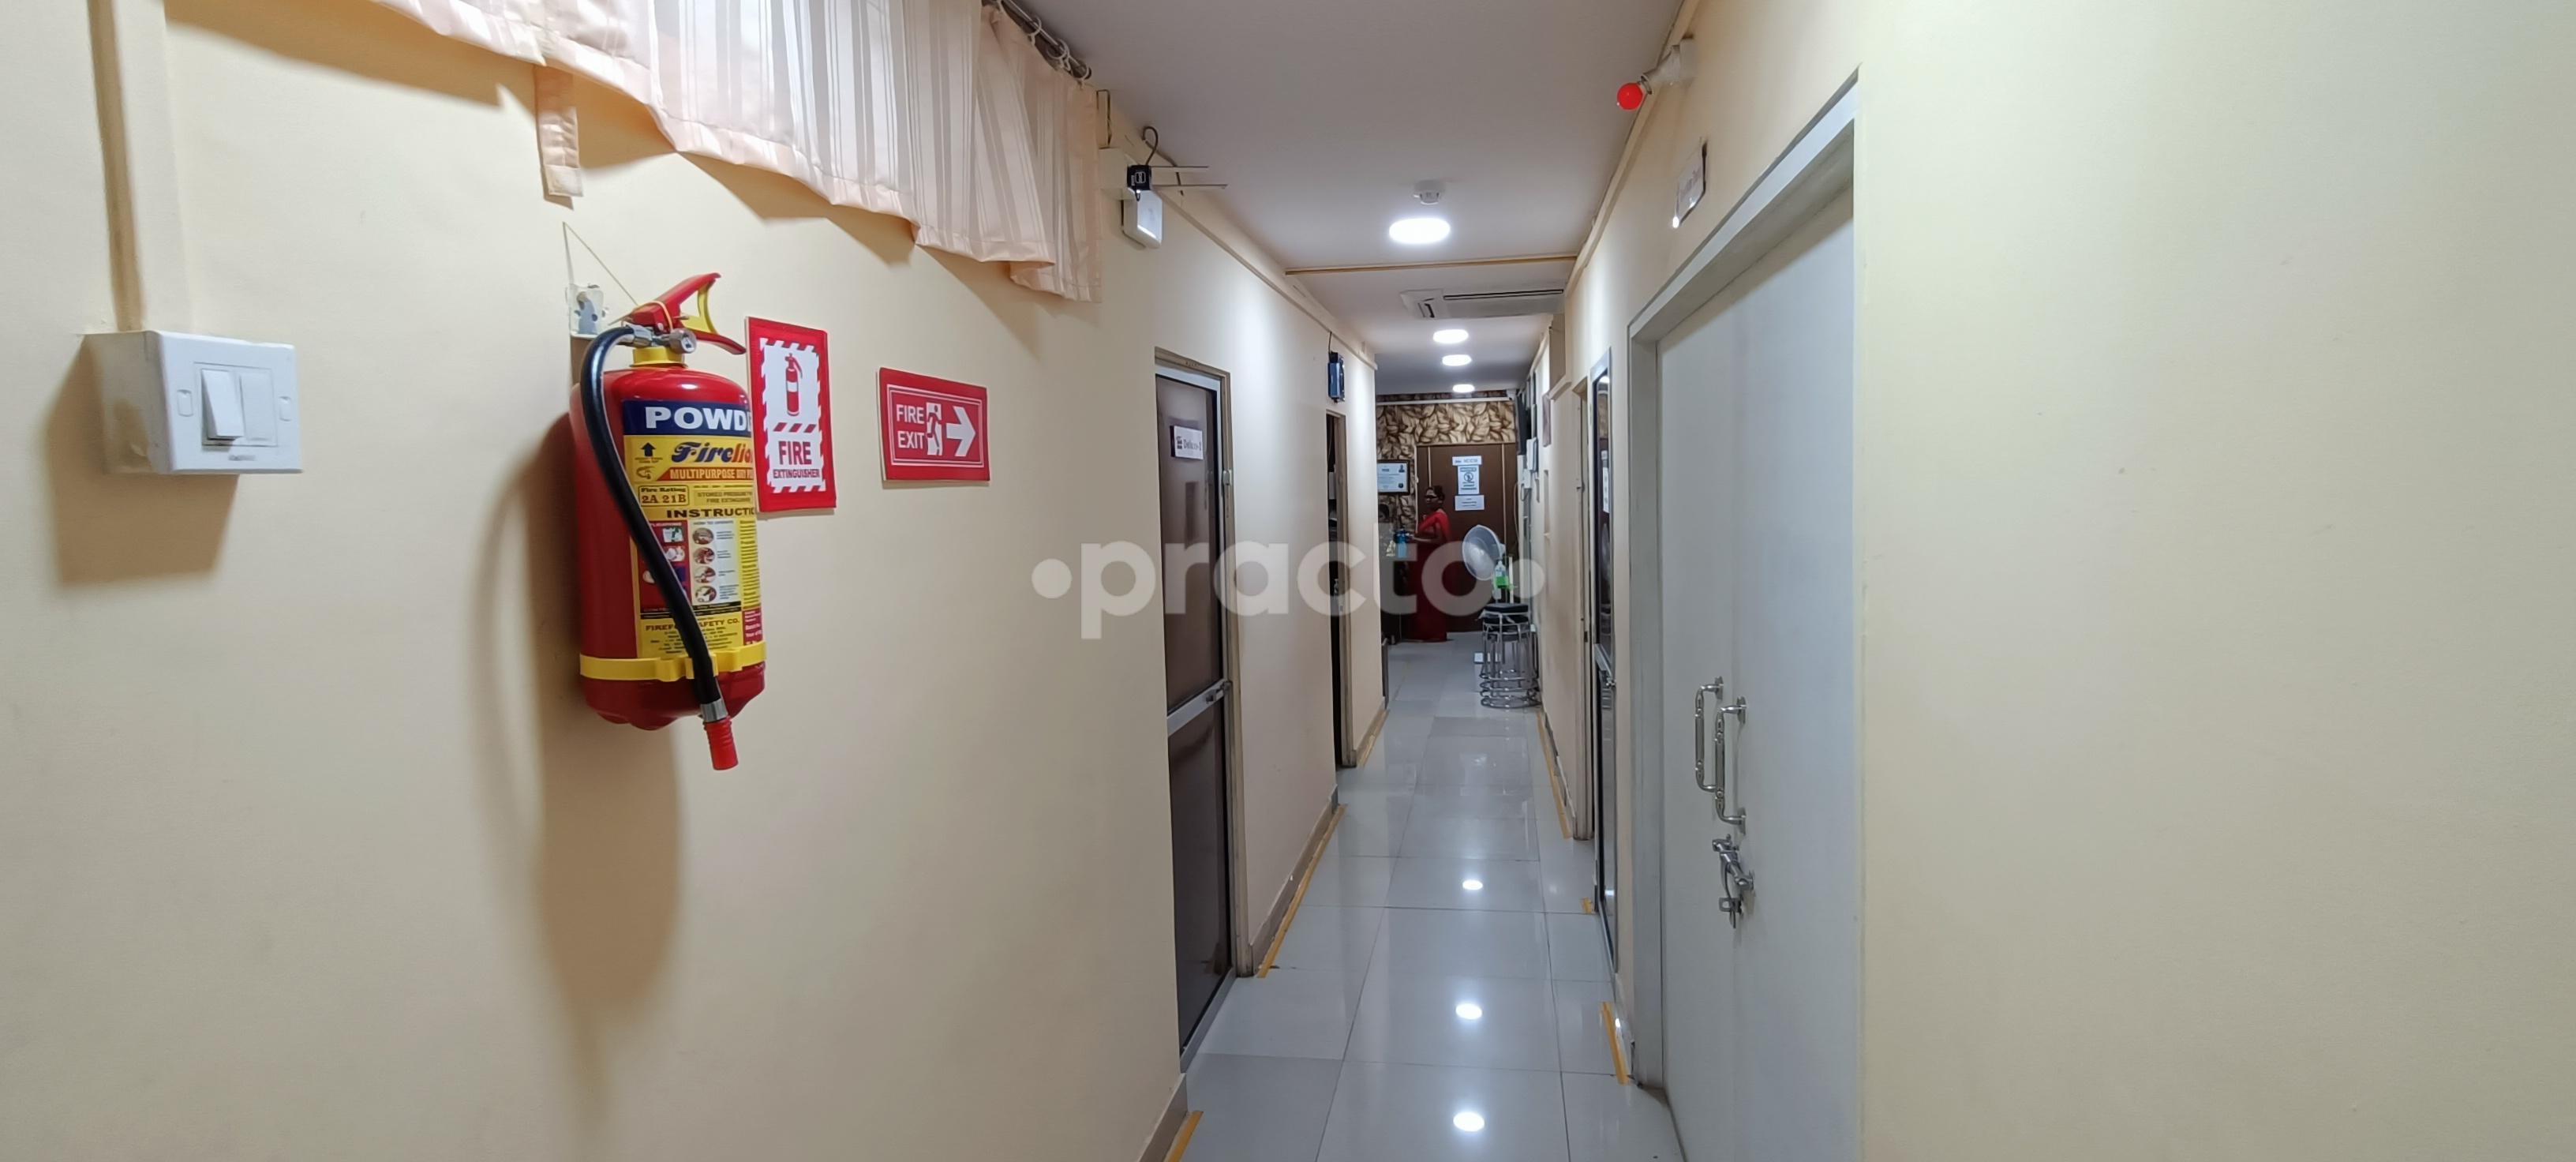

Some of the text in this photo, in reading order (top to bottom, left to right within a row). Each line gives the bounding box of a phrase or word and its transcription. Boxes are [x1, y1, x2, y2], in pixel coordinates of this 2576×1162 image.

[896, 403, 925, 425] FIRE
[897, 430, 925, 449] EXIT
[778, 440, 812, 465] FIRE
[670, 468, 736, 479] MULTIPURPOSE
[773, 468, 820, 478] EXTINGUISHER
[642, 493, 687, 504] 2A 21B
